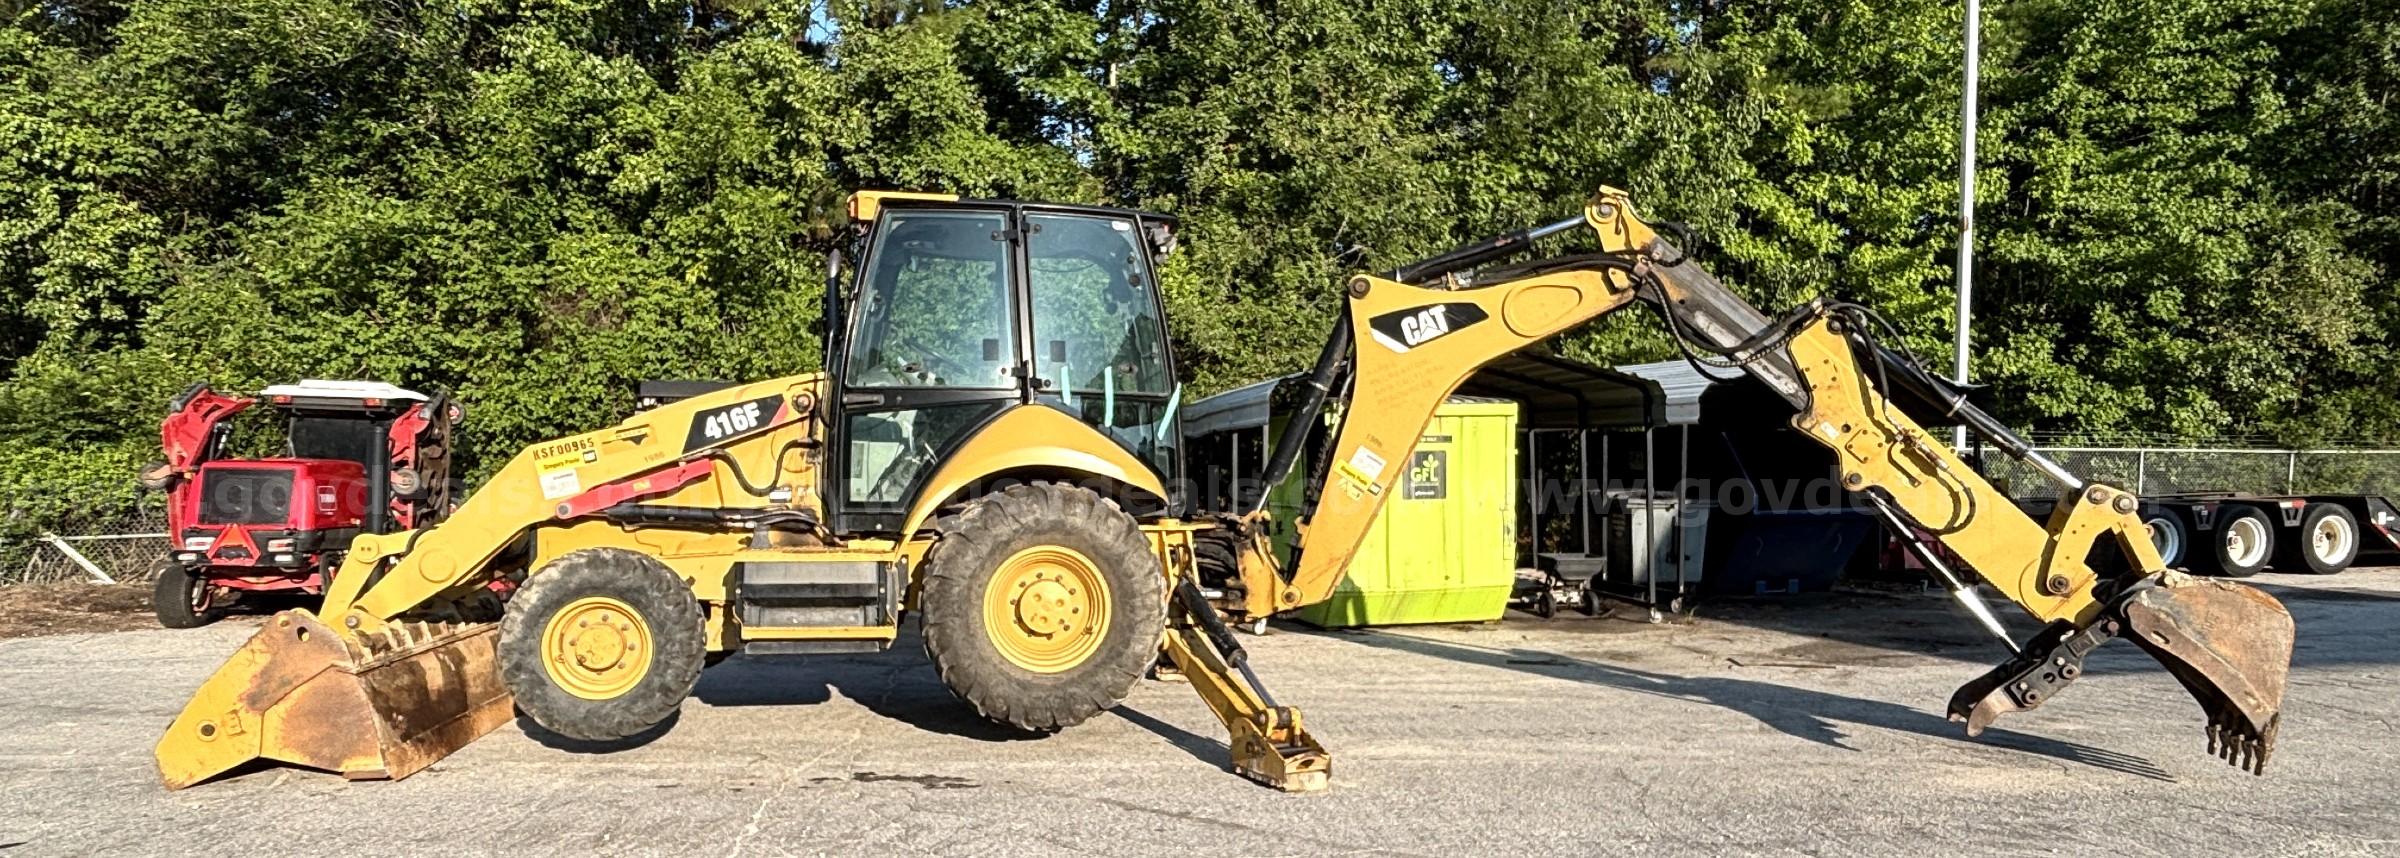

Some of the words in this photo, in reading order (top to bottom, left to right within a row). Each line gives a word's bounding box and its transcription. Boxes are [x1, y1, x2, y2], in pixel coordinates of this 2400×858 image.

[1400, 304, 1448, 346] CAT
[704, 402, 761, 439] 416F
[533, 438, 594, 461] KSF00965
[1411, 464, 1438, 482] GFL
